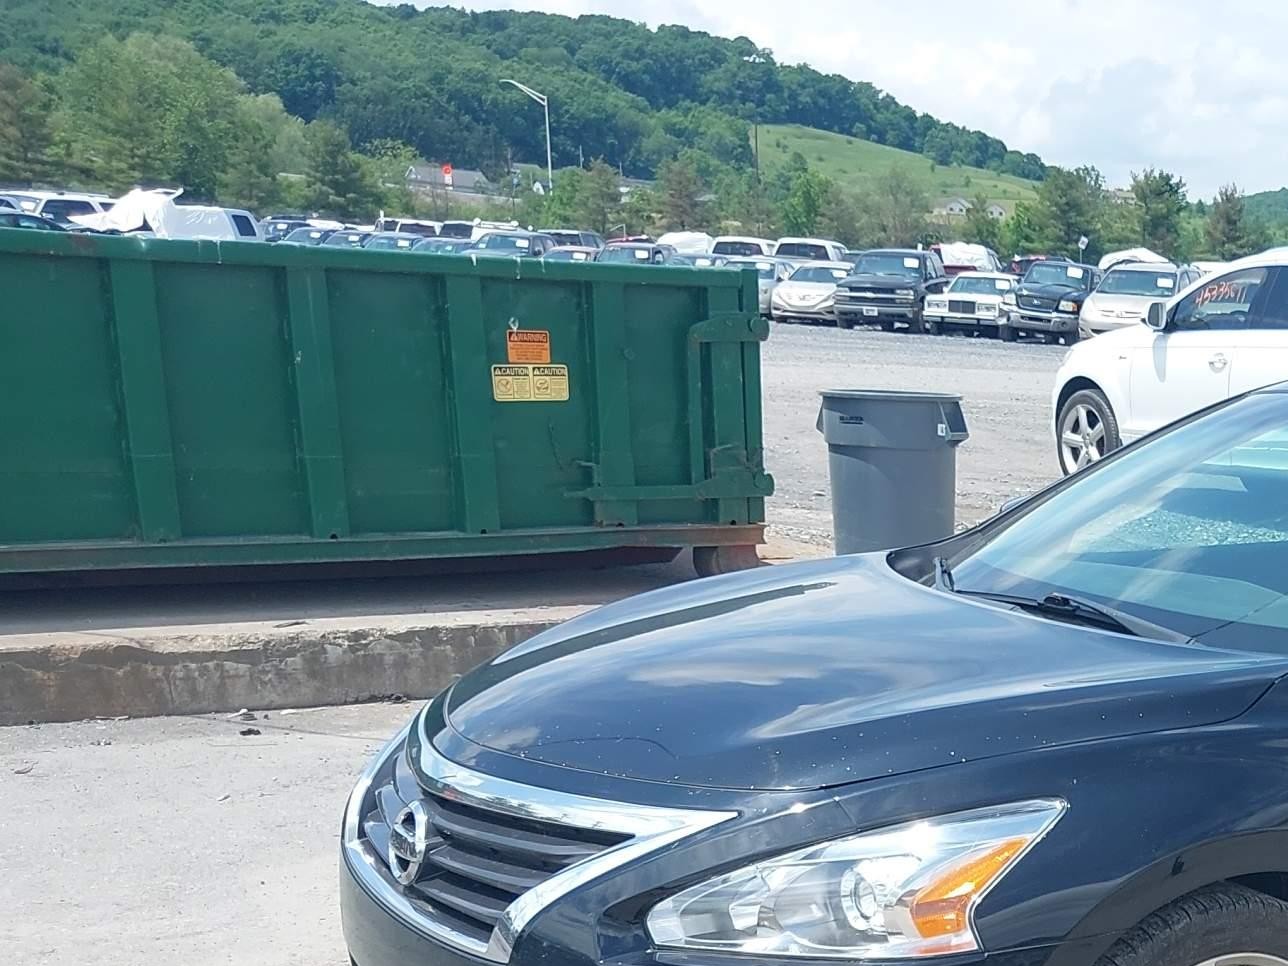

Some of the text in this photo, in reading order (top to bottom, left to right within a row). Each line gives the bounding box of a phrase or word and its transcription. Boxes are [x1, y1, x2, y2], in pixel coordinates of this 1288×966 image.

[517, 332, 547, 342] WARNING
[501, 367, 529, 375] CAUTION
[540, 367, 567, 376] CAUTION
